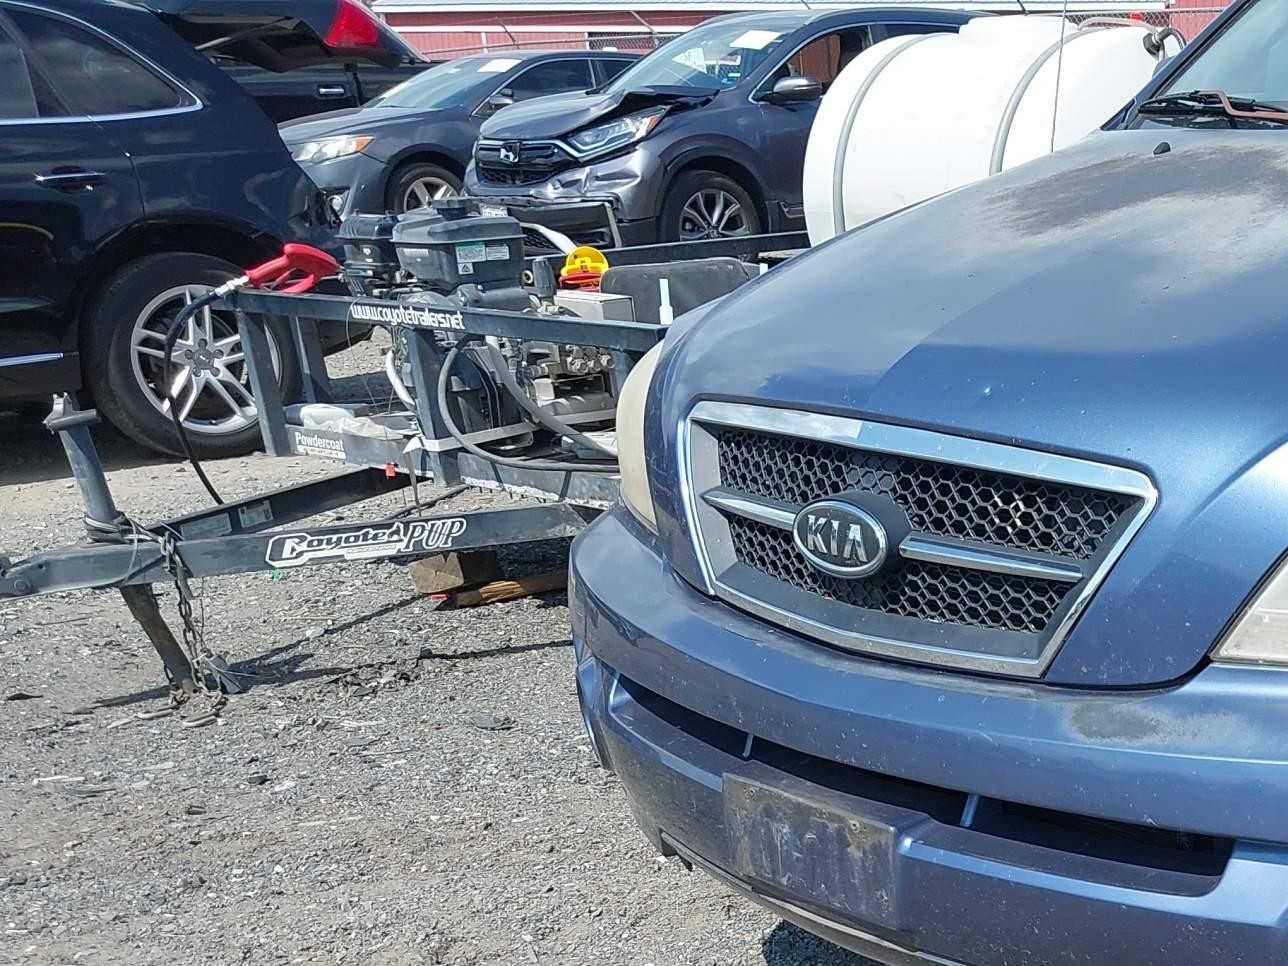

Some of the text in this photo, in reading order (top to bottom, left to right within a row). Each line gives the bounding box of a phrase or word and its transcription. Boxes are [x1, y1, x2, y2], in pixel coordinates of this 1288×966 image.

[295, 431, 345, 452] Powdercoat
[266, 518, 467, 567] Coyote PUP
[807, 514, 869, 562] KIA
